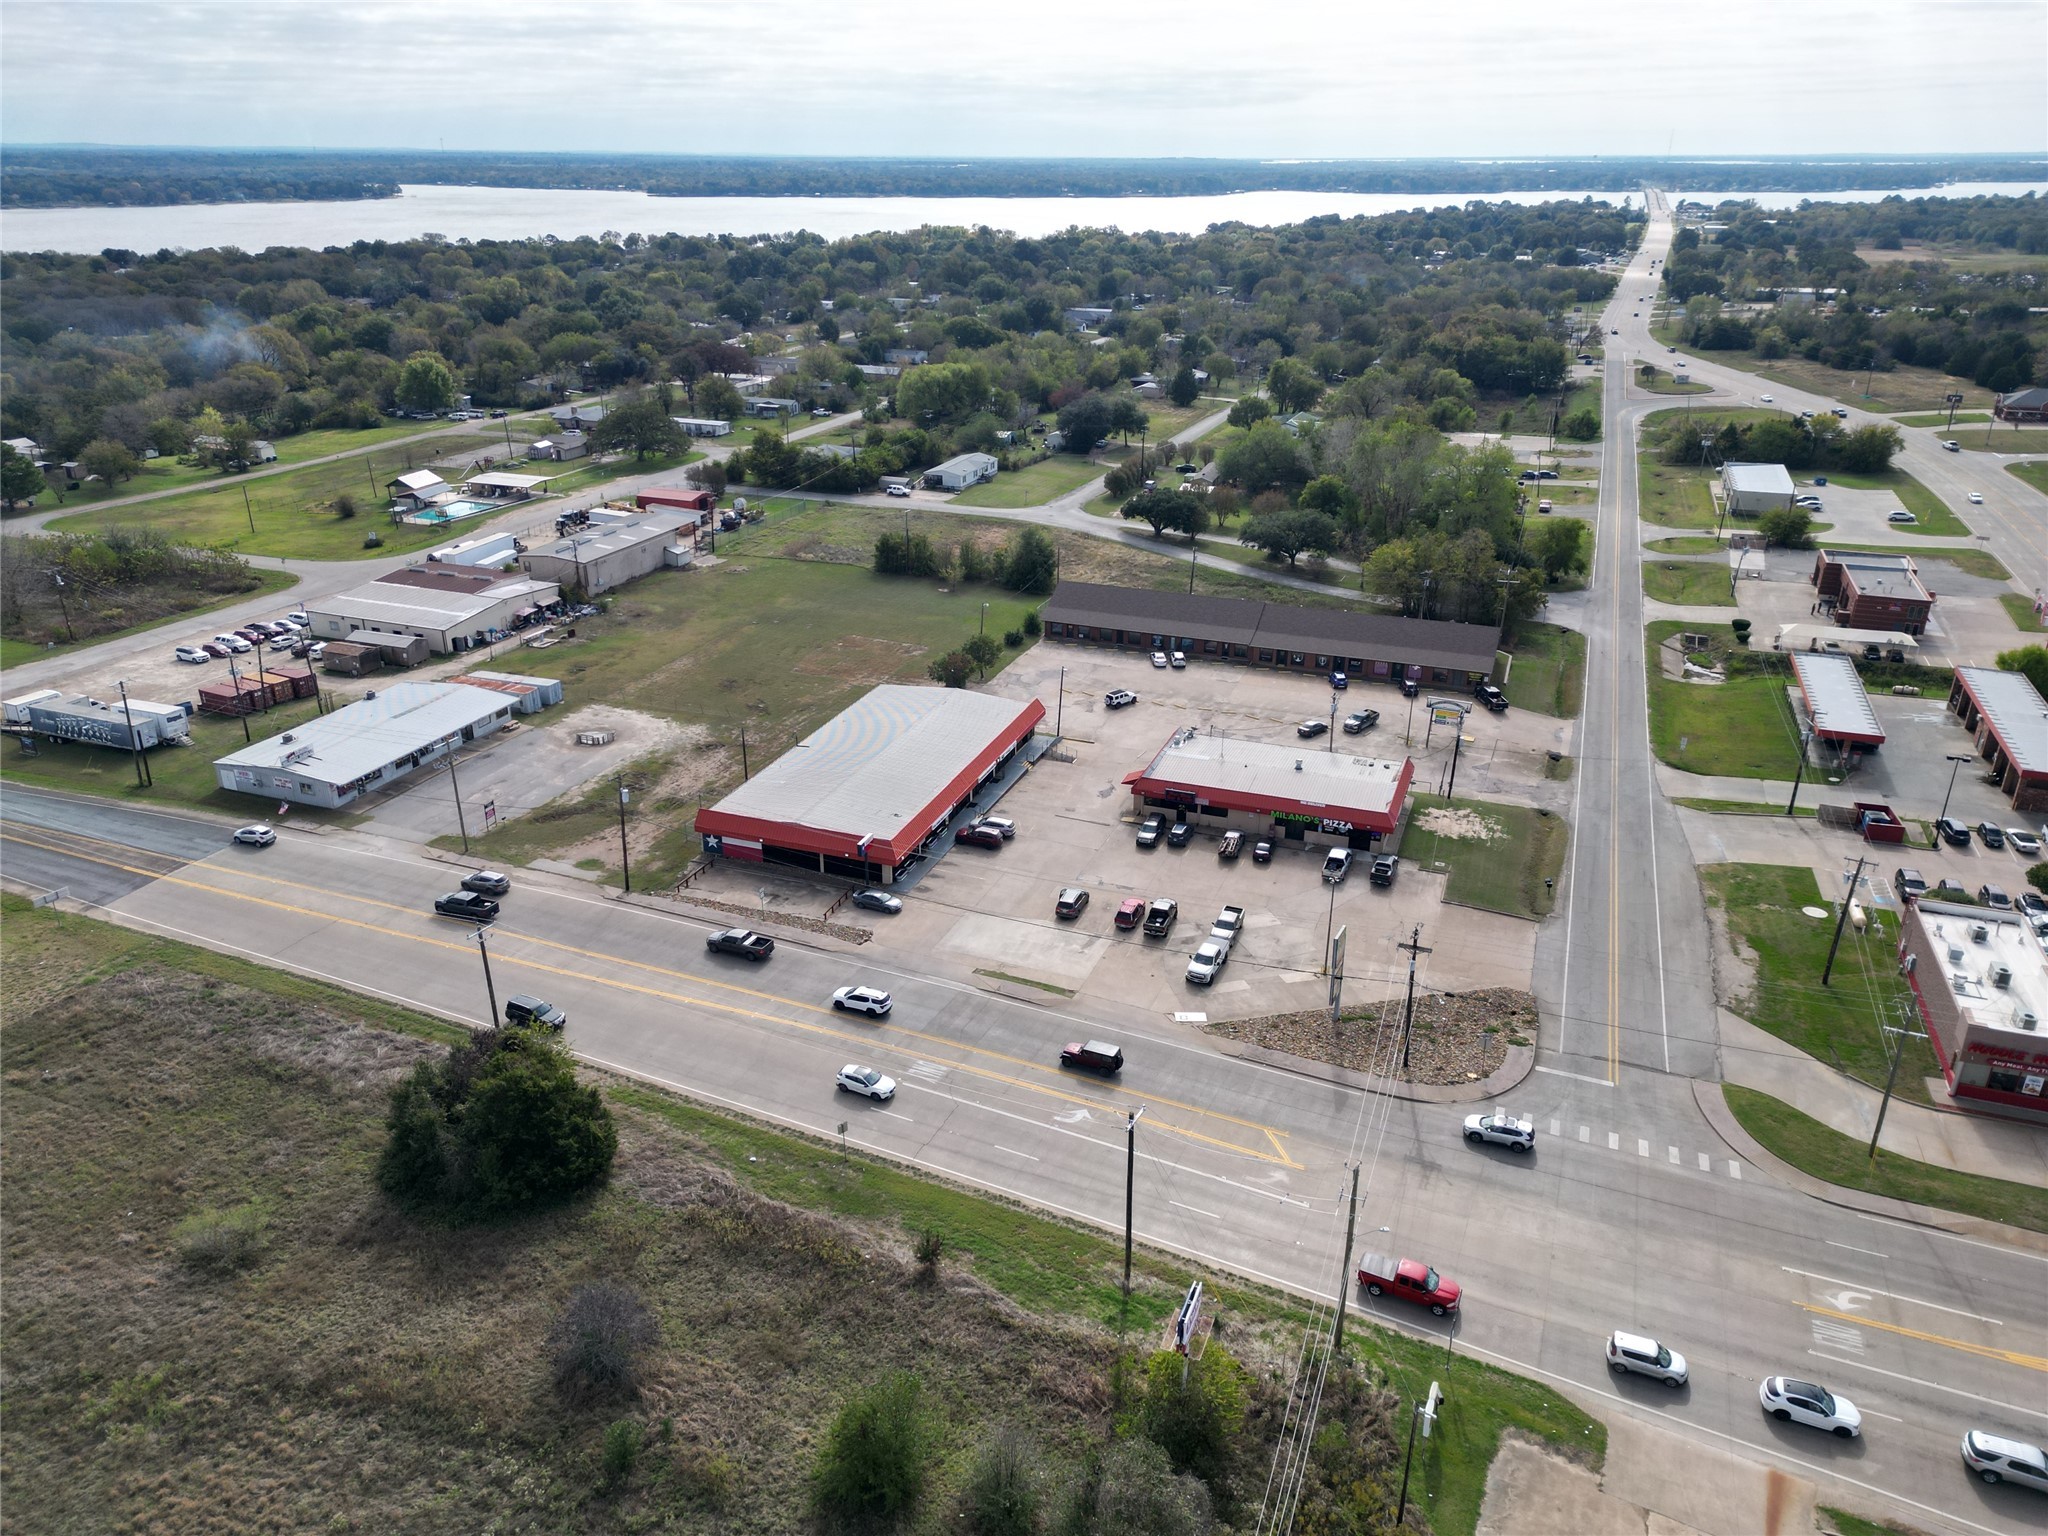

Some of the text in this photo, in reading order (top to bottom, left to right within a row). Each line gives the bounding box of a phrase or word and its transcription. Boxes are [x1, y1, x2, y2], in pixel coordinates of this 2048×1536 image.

[1270, 810, 1320, 824] MILANO'S
[1323, 818, 1354, 830] PIZZA
[1992, 1060, 2006, 1068] Any
[1811, 1319, 1865, 1356] ONLY
